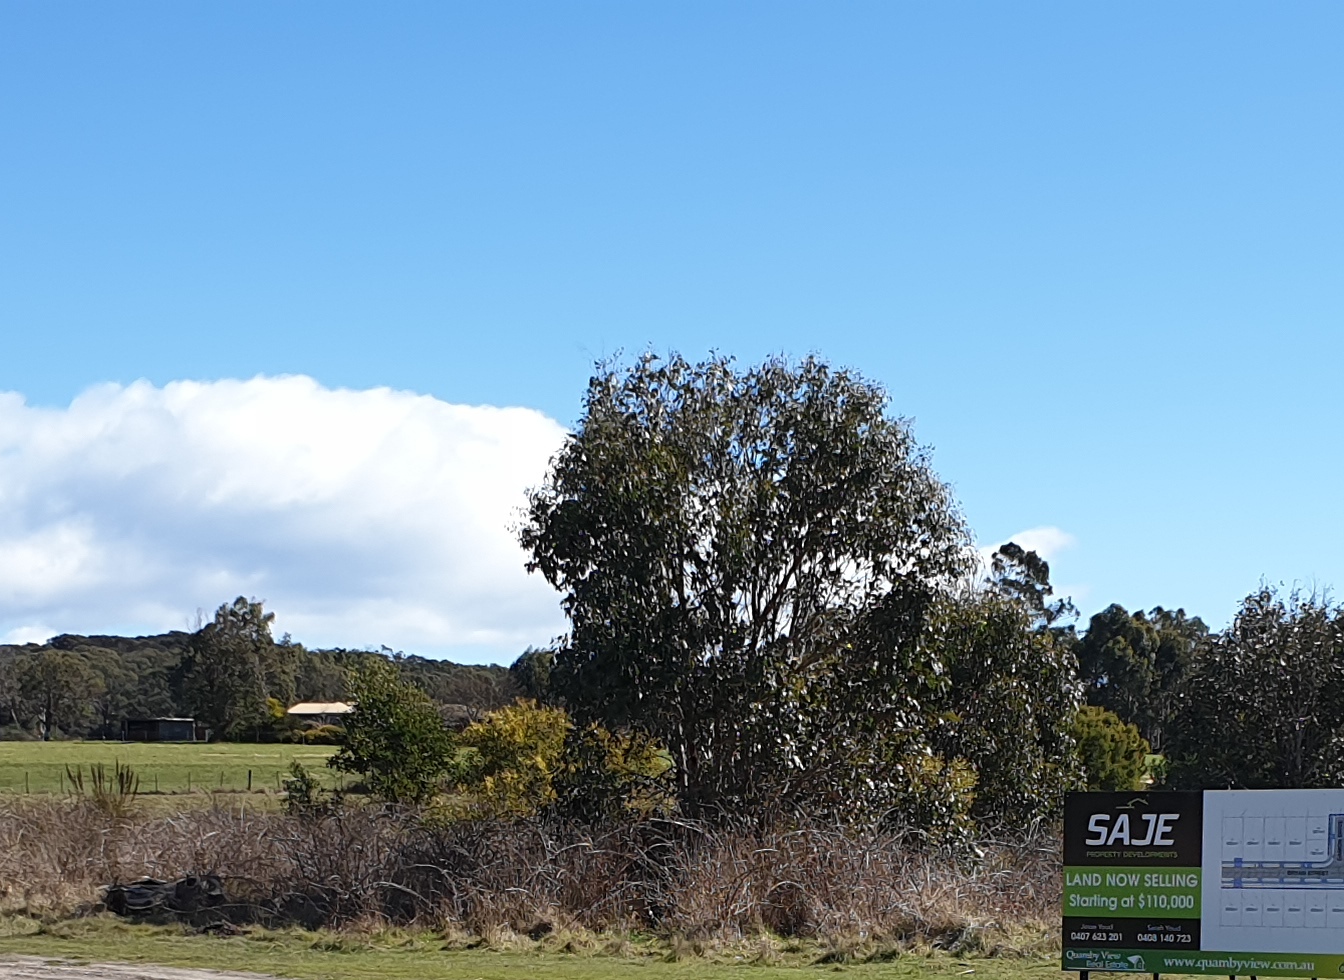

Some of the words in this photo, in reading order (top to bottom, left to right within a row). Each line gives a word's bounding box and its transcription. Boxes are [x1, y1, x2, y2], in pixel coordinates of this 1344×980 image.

[1085, 813, 1180, 846] SAJE
[1066, 873, 1102, 887] LAND
[1106, 873, 1140, 887] NOW
[1144, 873, 1199, 888] SELLING
[1069, 893, 1118, 911] Starting
[1121, 894, 1135, 908] at
[1138, 893, 1194, 911] $110,000
[1108, 932, 1123, 942] 201
[1176, 934, 1192, 943] 723
[1164, 957, 1315, 971] www.quambyview.com.au
